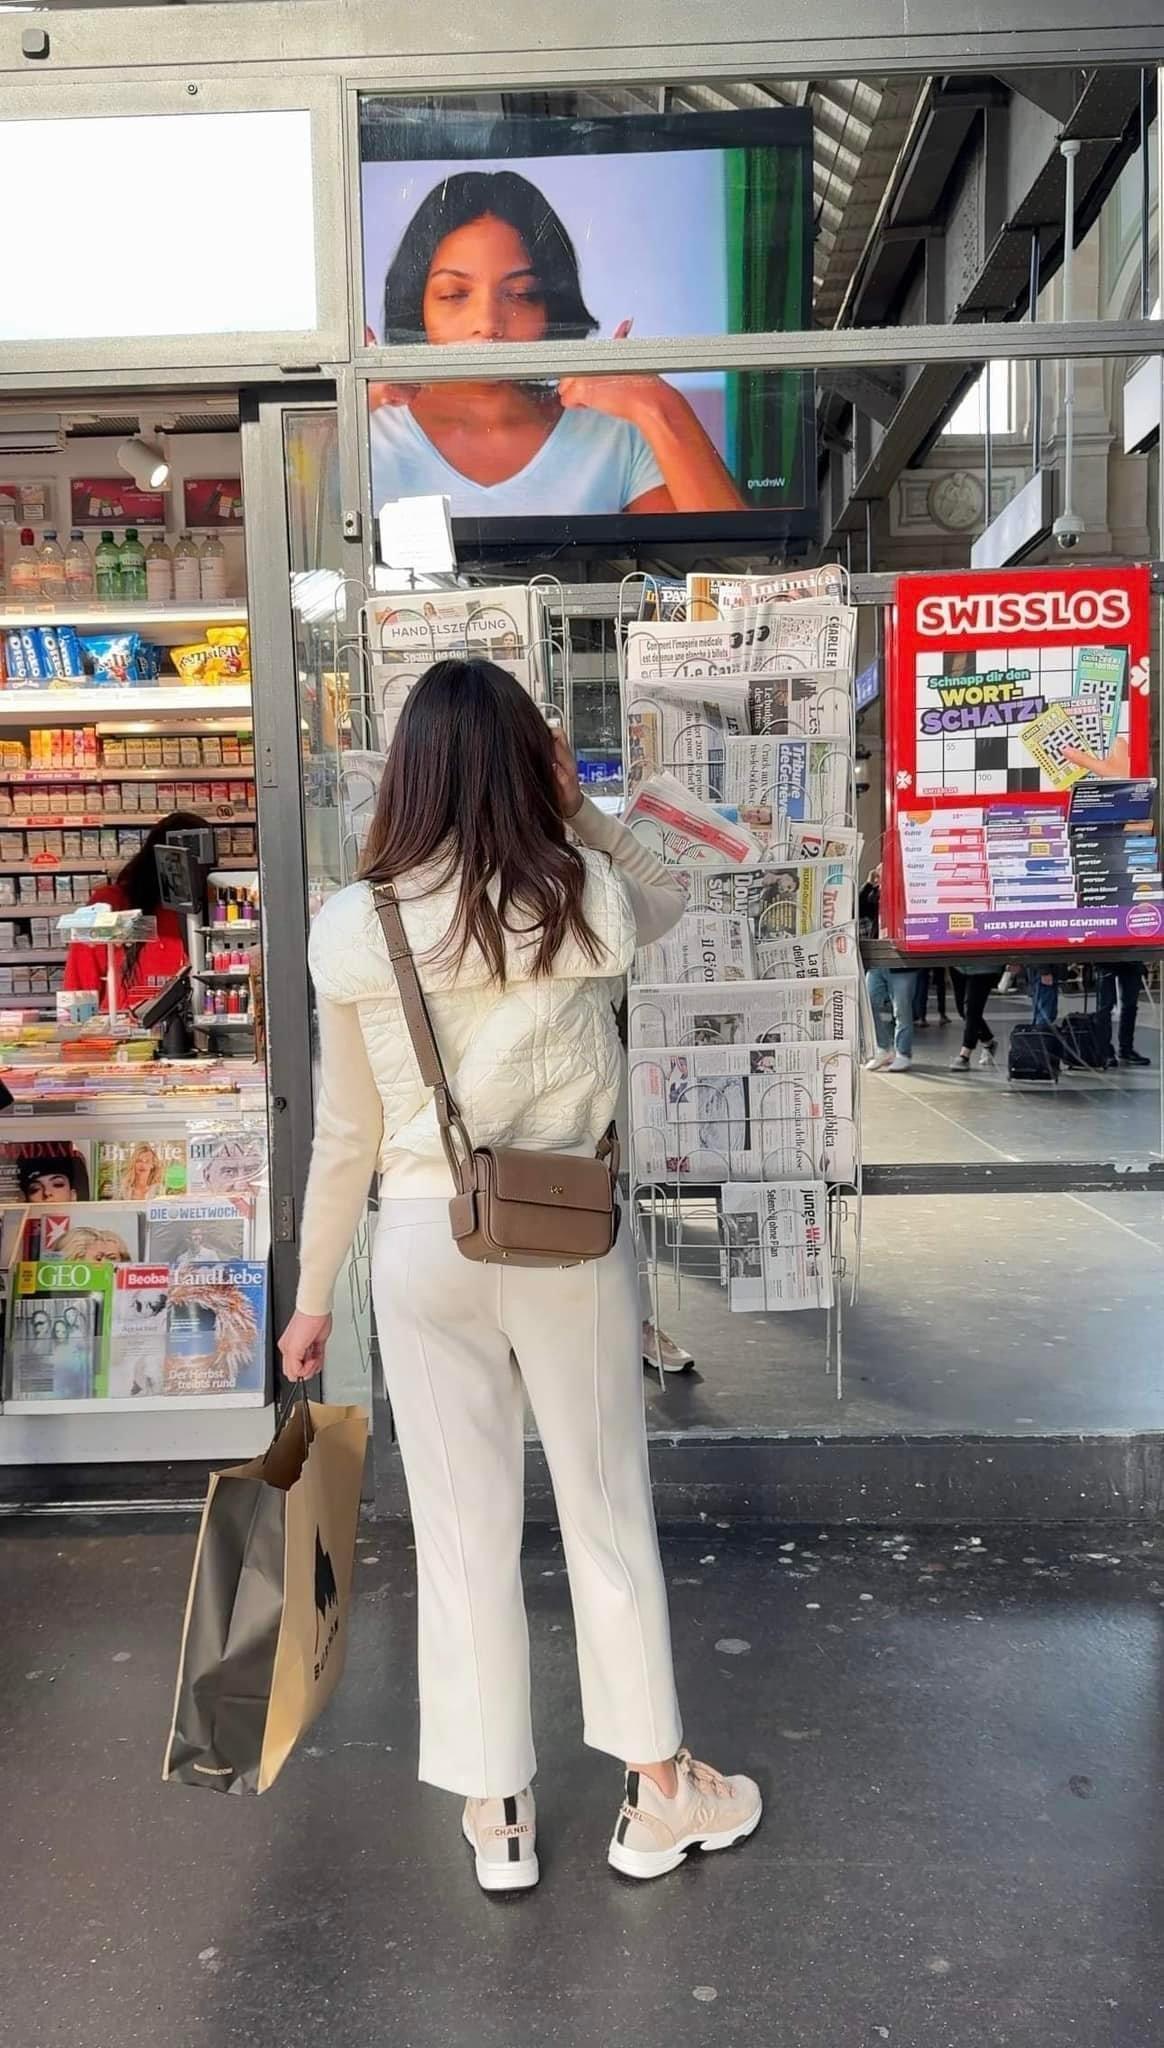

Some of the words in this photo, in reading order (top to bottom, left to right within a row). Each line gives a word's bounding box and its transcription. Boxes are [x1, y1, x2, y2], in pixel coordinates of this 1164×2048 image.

[919, 594, 1128, 634] SWISSLOS
[391, 618, 507, 638] HANDELSZEITUNG
[928, 675, 984, 689] Schnapp
[985, 670, 1004, 682] dir
[1005, 669, 1030, 681] den
[940, 683, 1023, 707] WORT-
[921, 698, 1045, 734] SCHATZ!
[791, 745, 805, 800] Tribune
[984, 921, 1007, 930] HIER
[1008, 920, 1047, 929] SPIELEN
[1048, 919, 1070, 928] UND
[1070, 917, 1118, 927] GEWINNEN
[823, 1073, 837, 1085] la
[822, 1086, 838, 1148] Repubblica
[150, 1207, 168, 1220] DIE
[800, 1189, 817, 1226] junge
[37, 1264, 91, 1287] GEO
[174, 1266, 262, 1285] LandLiebe
[169, 1369, 187, 1379] Der
[189, 1368, 225, 1378] Herbst
[211, 1377, 236, 1388] rund
[494, 1824, 529, 1837] CHANEL
